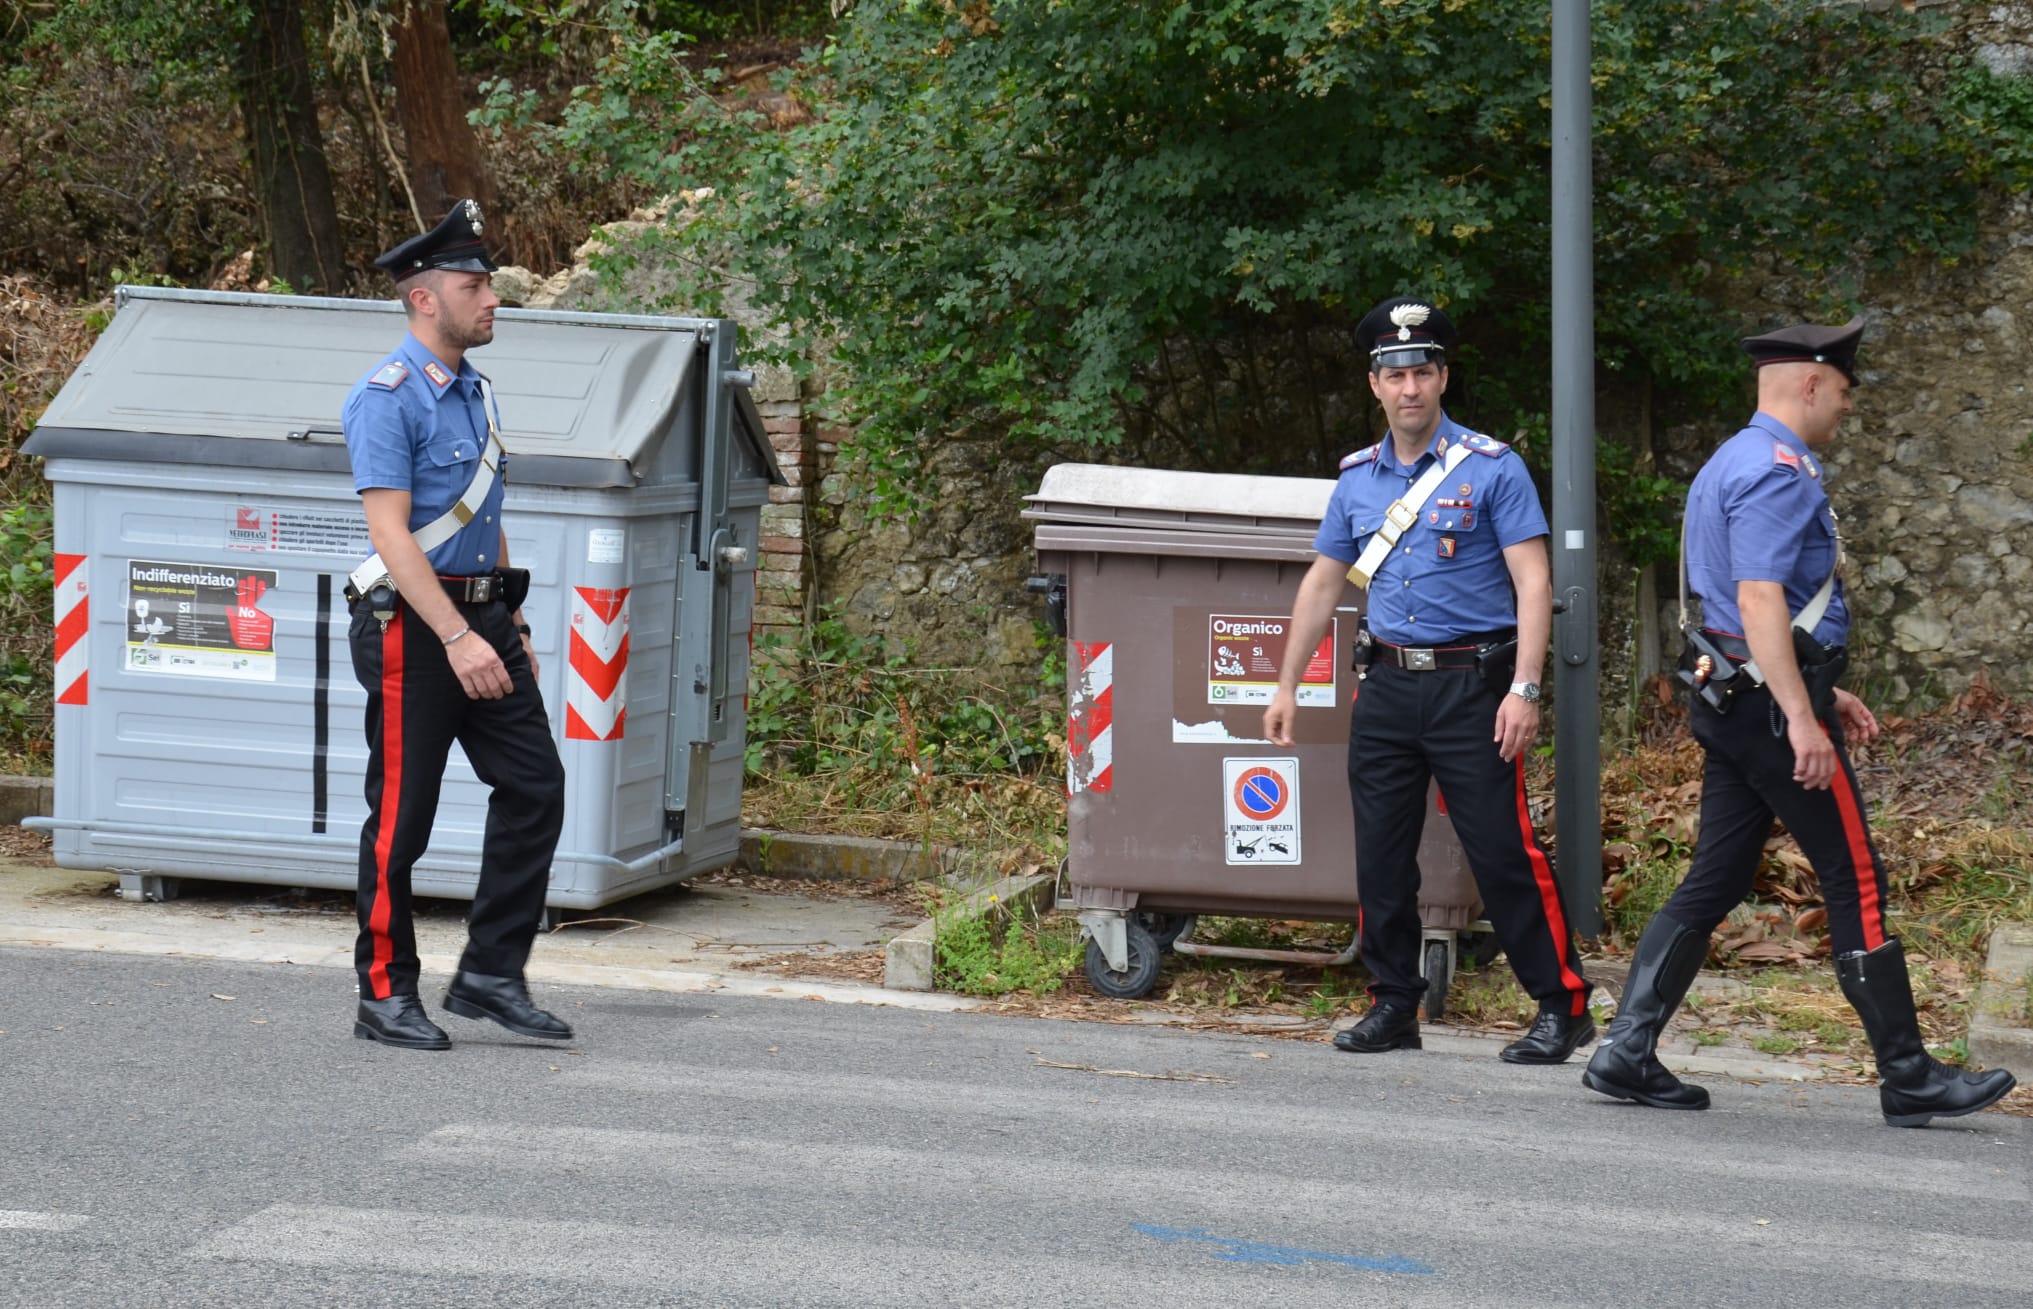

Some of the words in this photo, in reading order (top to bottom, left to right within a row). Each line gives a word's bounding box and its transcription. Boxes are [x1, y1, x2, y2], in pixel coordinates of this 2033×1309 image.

[132, 567, 236, 587] Indifferenziato
[238, 606, 256, 618] No
[1213, 620, 1283, 636] Organico
[1230, 824, 1264, 832] RIMOZIONE
[1266, 824, 1294, 832] FORZATA
